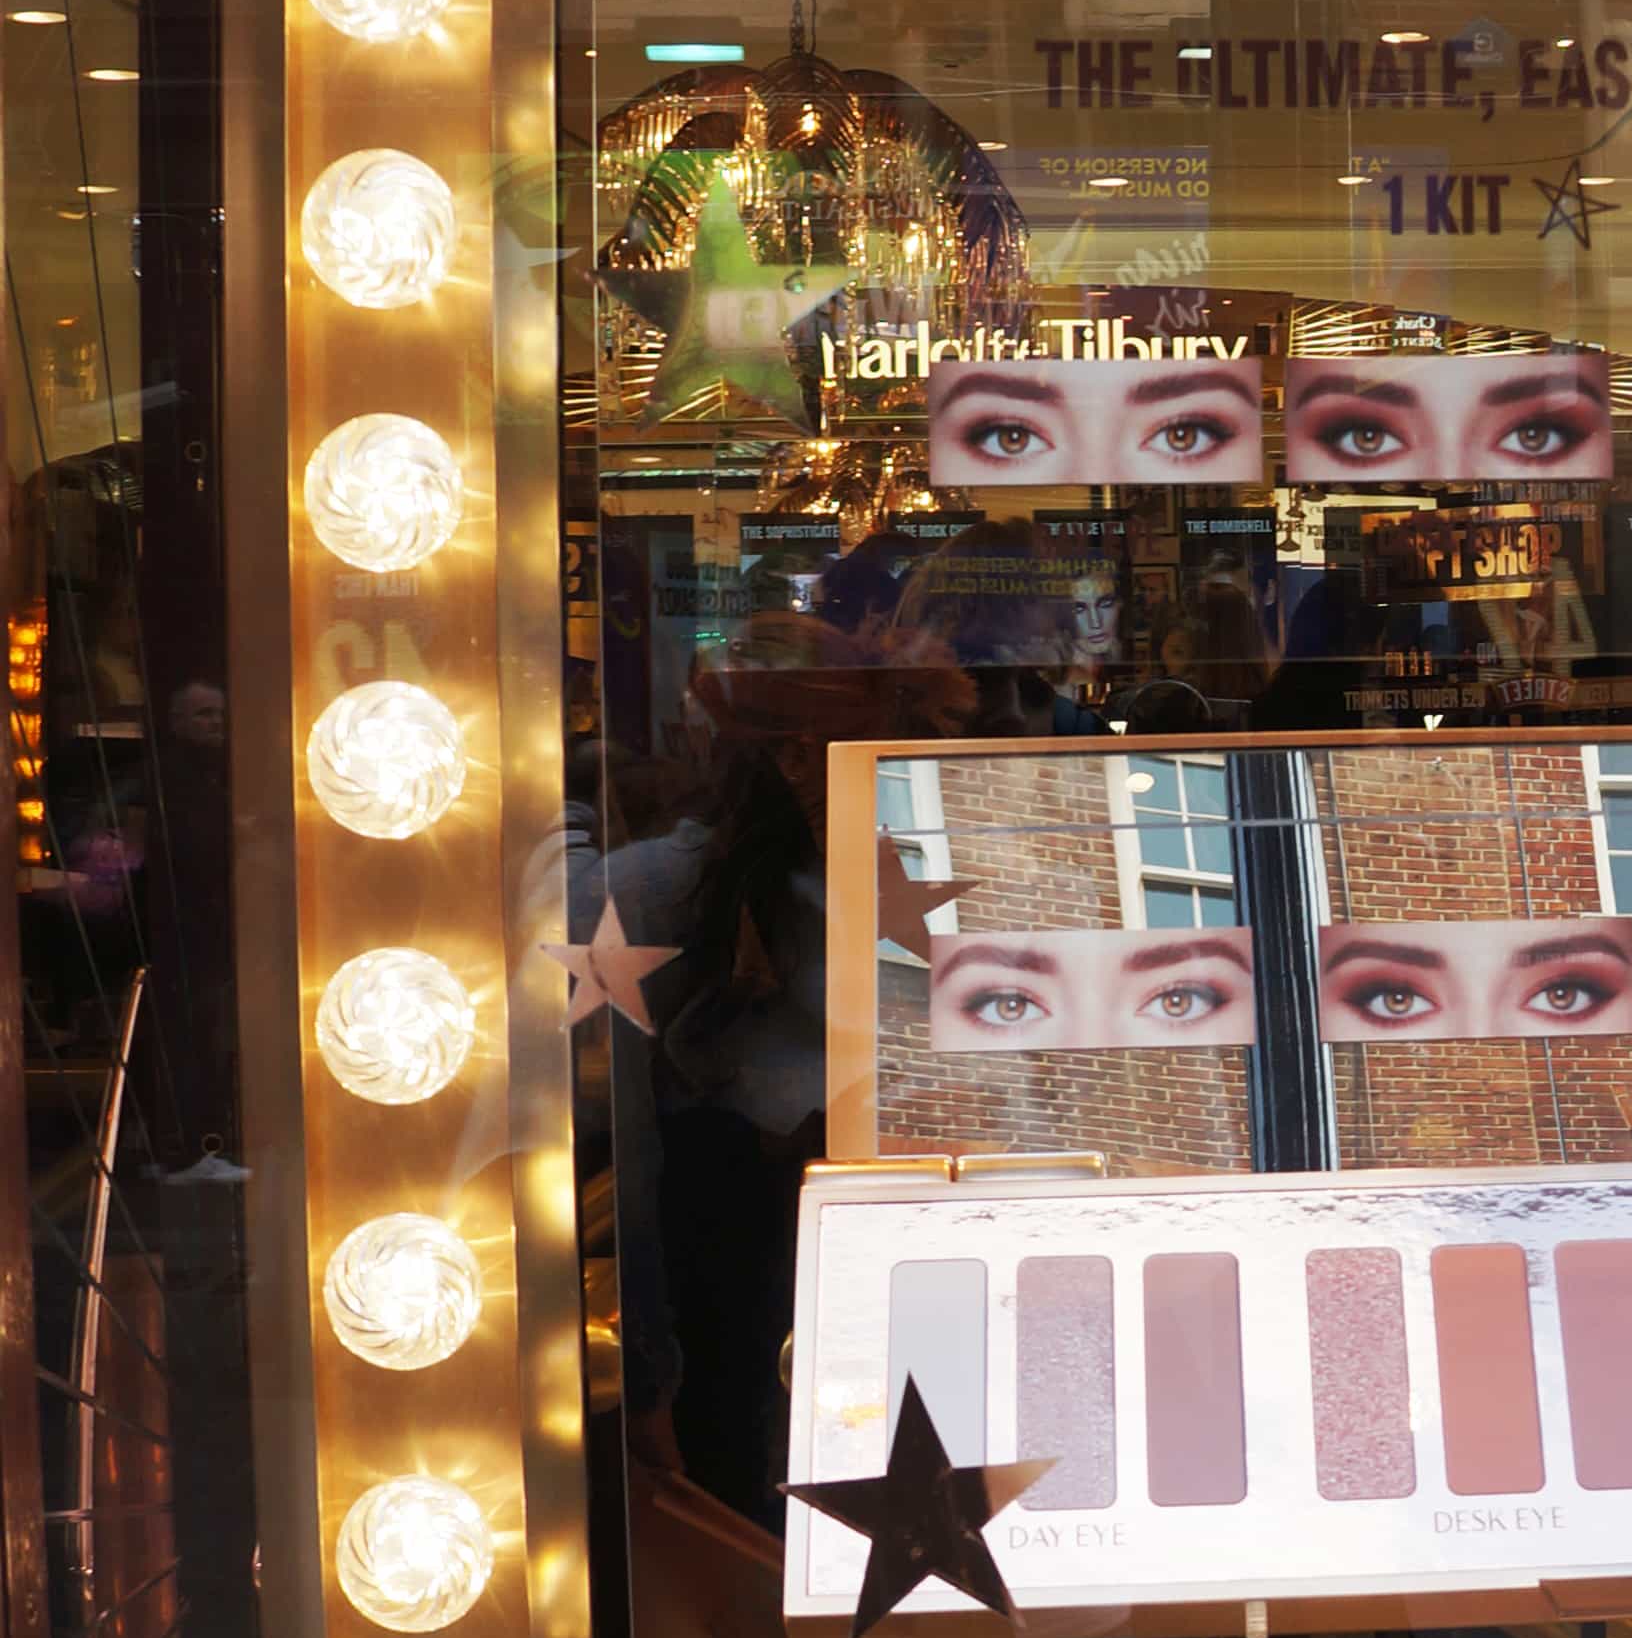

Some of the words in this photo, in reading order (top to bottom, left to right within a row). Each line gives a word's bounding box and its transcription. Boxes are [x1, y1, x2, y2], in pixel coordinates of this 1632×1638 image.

[1035, 41, 1153, 109] THE
[1178, 39, 1496, 121] ULTIMATE,
[1382, 176, 1403, 236] 1
[1427, 174, 1510, 235] KIT
[1344, 689, 1409, 710] TRINKETS
[1412, 688, 1458, 709] UNDER
[1433, 1507, 1507, 1534] DESK
[1515, 1506, 1568, 1531] EYE
[1009, 1524, 1065, 1550] DAY
[1076, 1523, 1129, 1548] EYE
